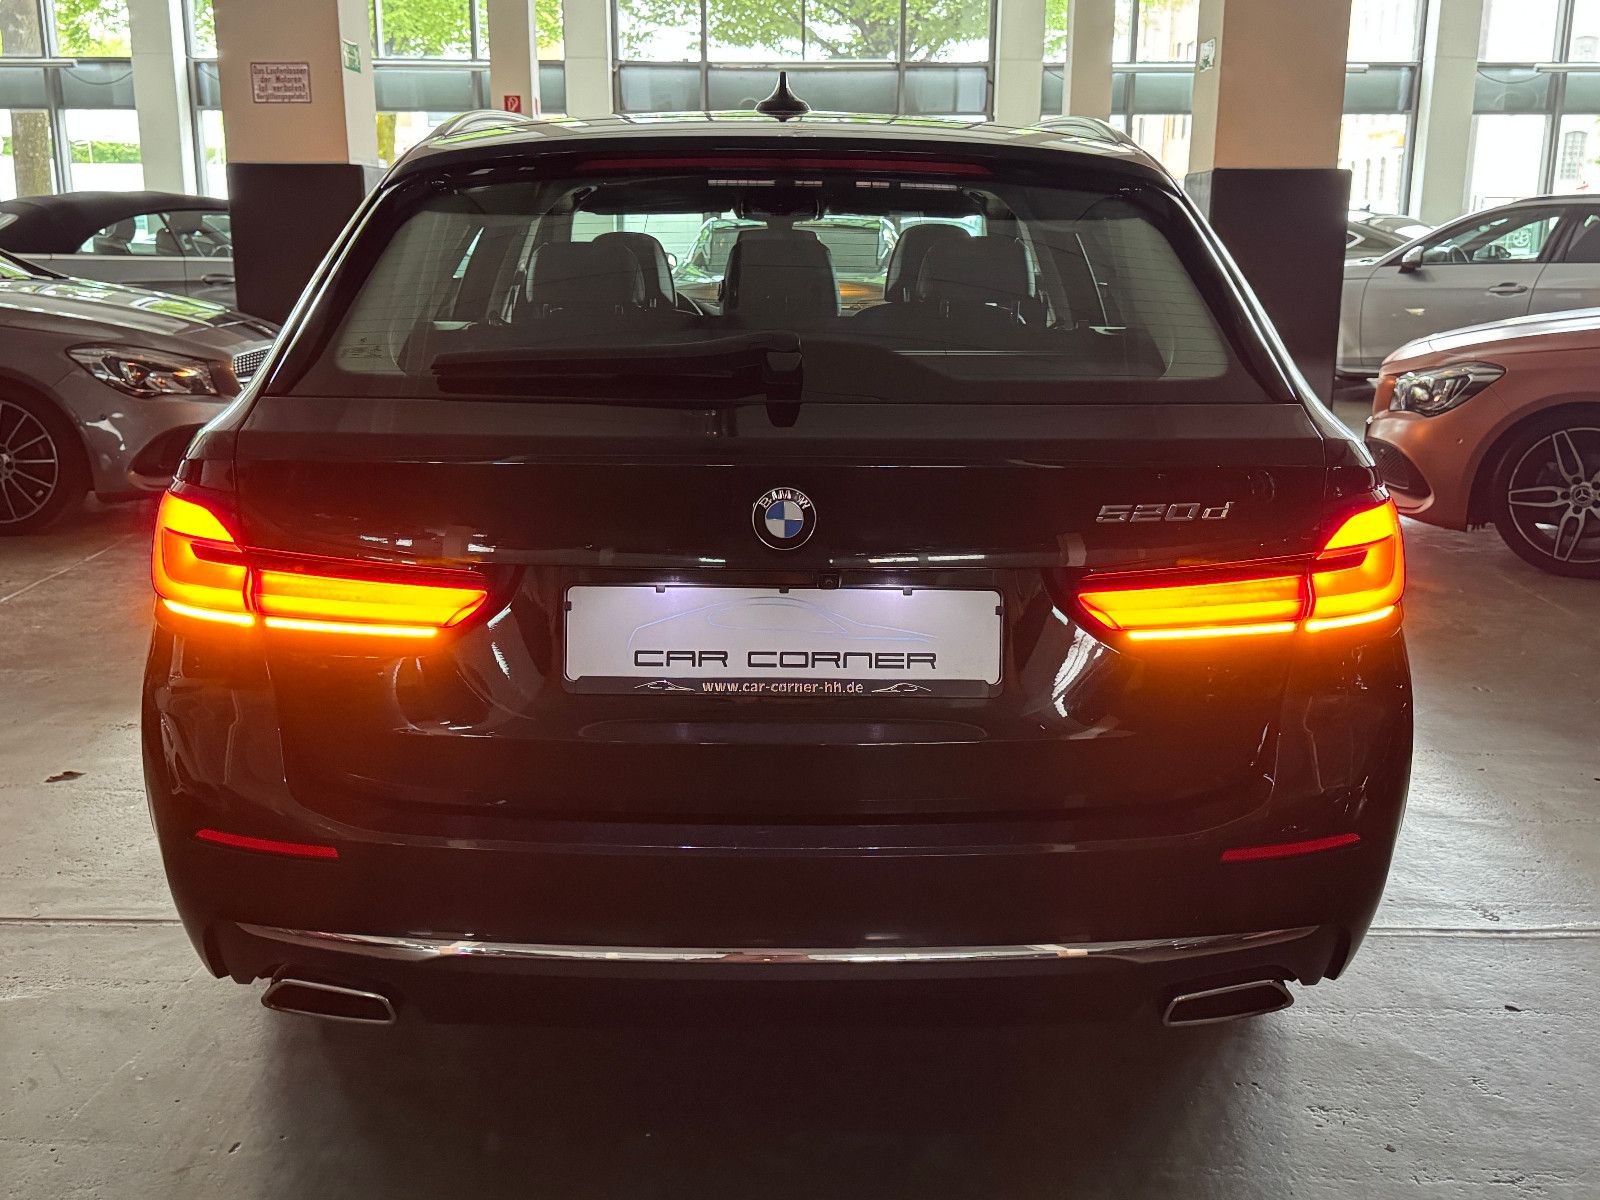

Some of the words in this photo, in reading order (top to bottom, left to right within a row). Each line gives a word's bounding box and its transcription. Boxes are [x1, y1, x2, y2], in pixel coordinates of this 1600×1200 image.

[758, 489, 811, 510] BMW
[1095, 501, 1235, 523] 520d
[634, 650, 729, 668] CAR
[747, 651, 937, 670] CORNER
[702, 681, 864, 693] www.car-corner-hh.de
